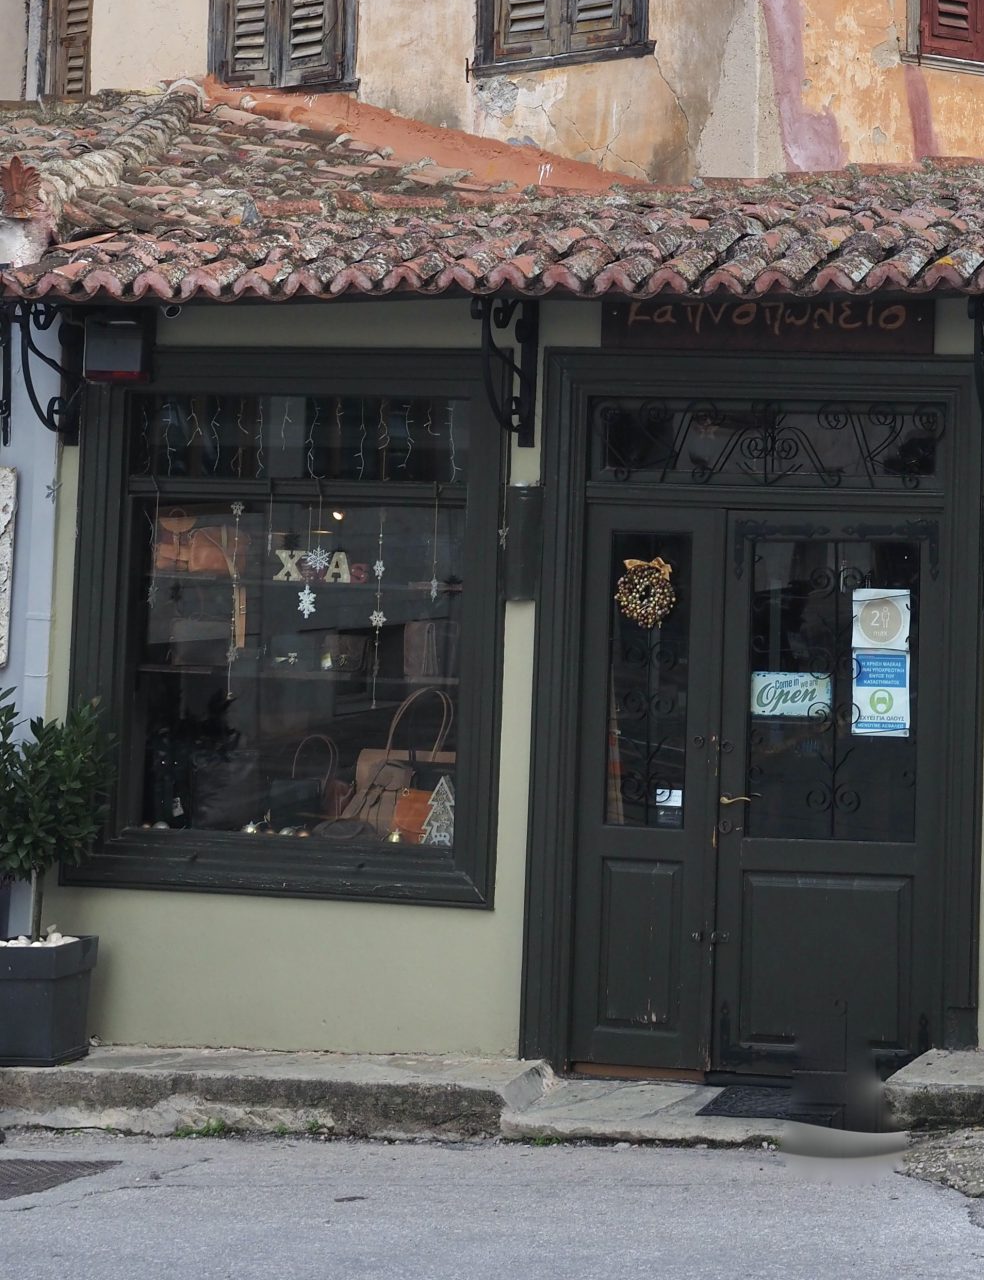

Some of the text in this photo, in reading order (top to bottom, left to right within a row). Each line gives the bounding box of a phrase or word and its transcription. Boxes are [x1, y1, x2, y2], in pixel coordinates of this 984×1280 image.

[871, 610, 880, 626] 2
[775, 680, 793, 690] Come
[794, 678, 800, 687] in
[757, 682, 817, 713] Open
